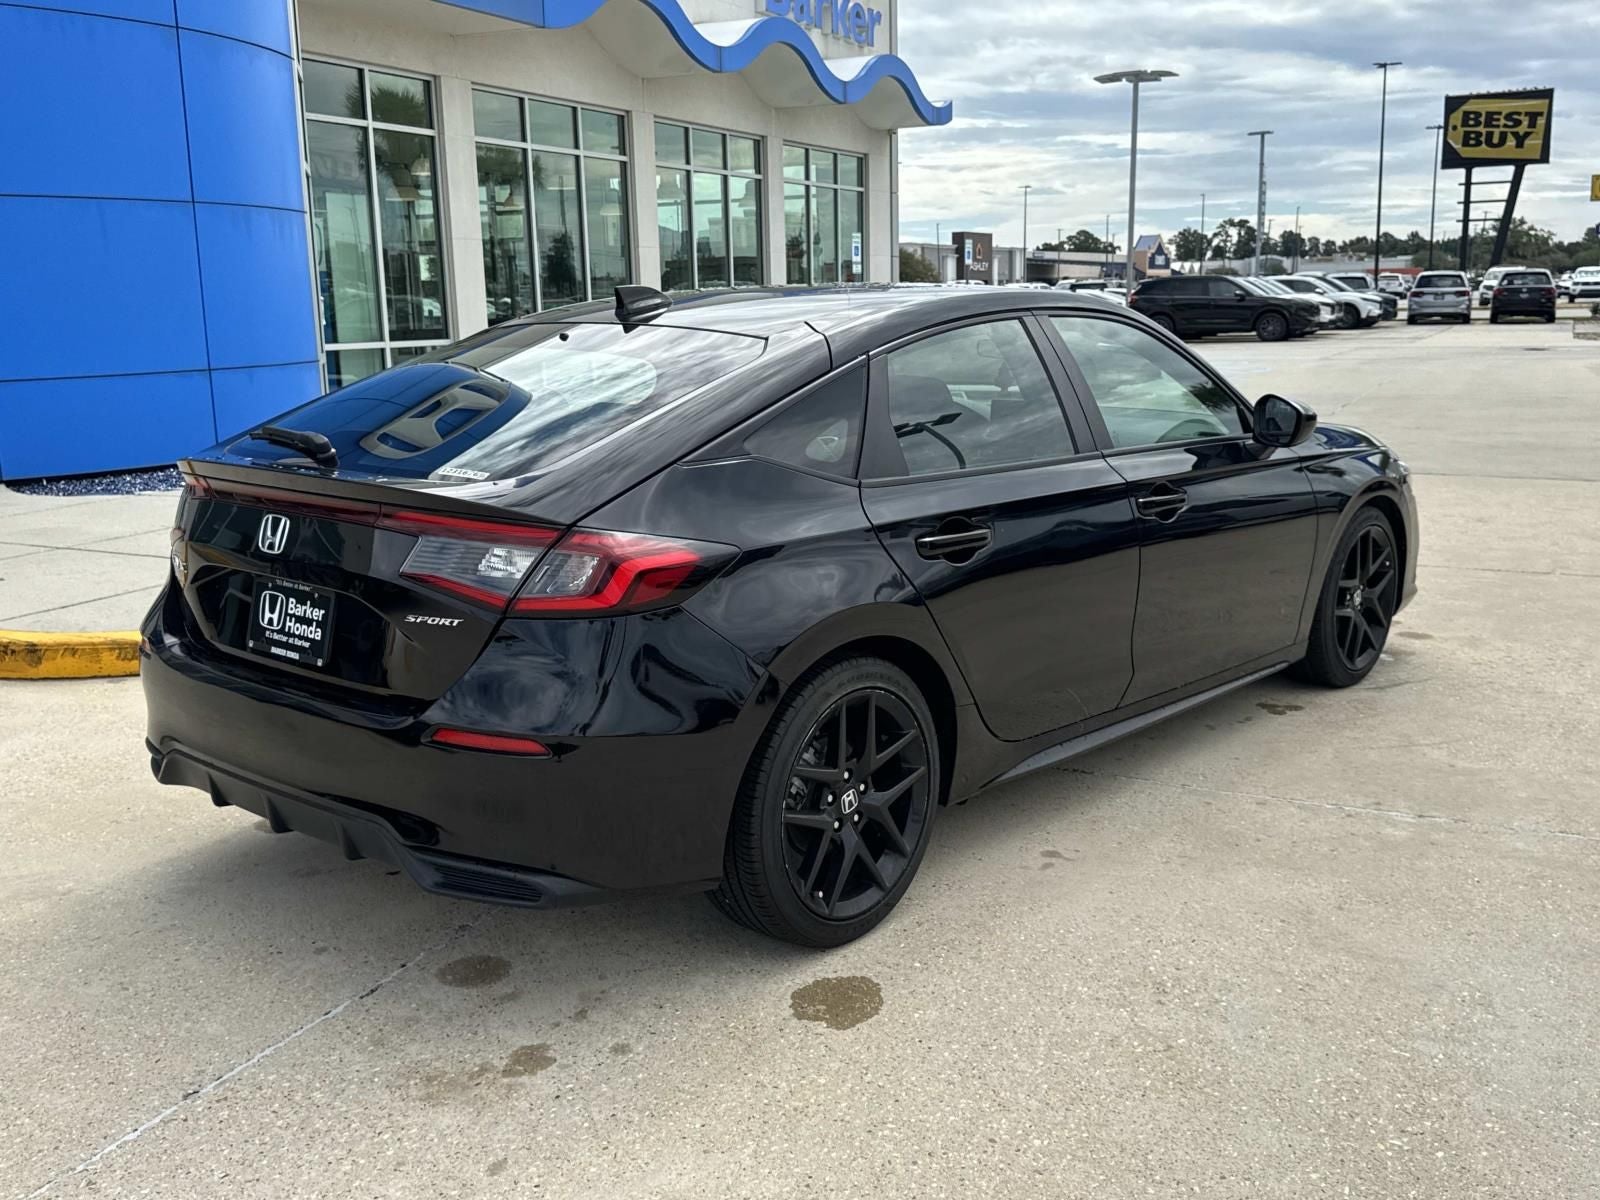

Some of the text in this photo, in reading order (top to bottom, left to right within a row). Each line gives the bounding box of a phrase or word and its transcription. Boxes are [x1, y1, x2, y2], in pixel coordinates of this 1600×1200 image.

[1461, 111, 1544, 129] BEST
[1461, 131, 1534, 149] BUY
[287, 597, 326, 621] Barker
[285, 616, 321, 640] Honda
[404, 615, 464, 626] SPORT
